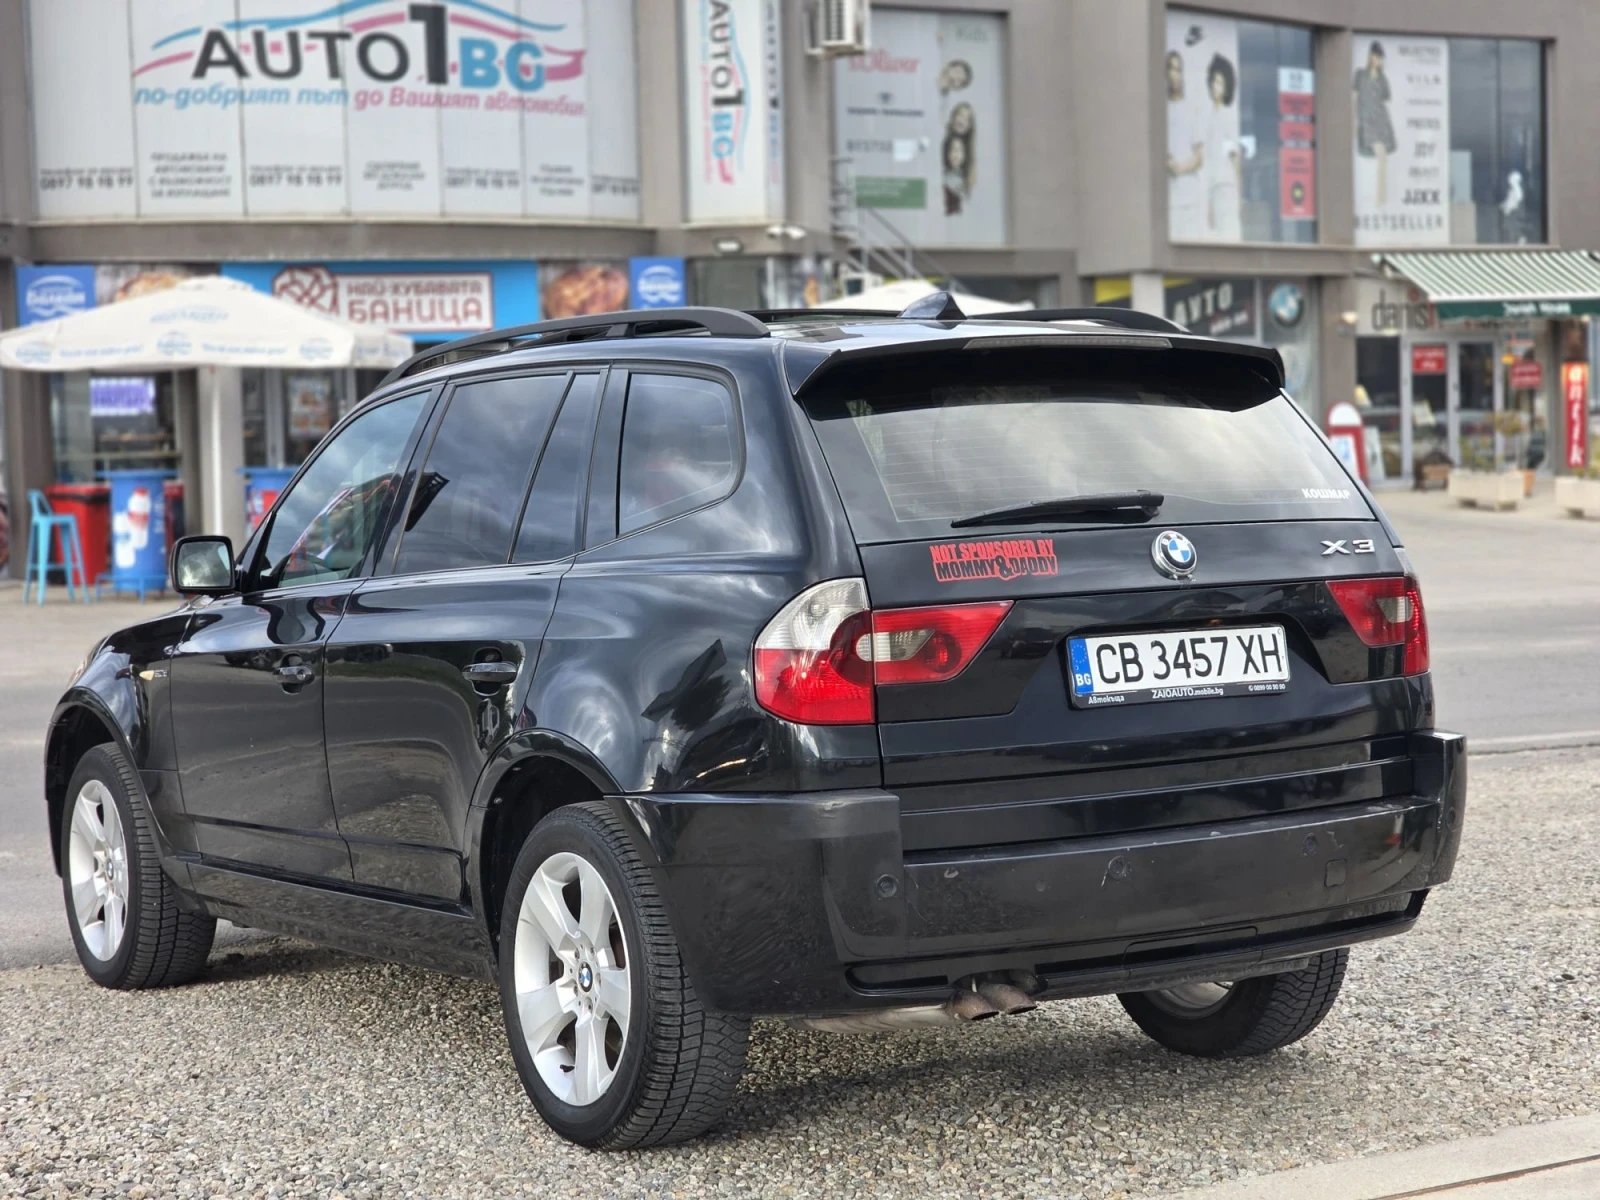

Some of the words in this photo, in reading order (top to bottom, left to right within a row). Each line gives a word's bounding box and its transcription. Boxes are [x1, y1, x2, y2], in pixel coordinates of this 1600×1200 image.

[135, 82, 290, 110] по-добрият
[297, 88, 349, 106] път
[354, 89, 383, 111] до
[348, 298, 483, 327] БАНИЦА
[1301, 488, 1351, 499] КОШМАР
[929, 544, 957, 562] NOT
[959, 540, 1035, 561] SPONSORED
[1036, 539, 1055, 556] BY
[1320, 539, 1376, 556] X3
[1095, 641, 1145, 685] CB
[1150, 636, 1229, 681] 3457
[1235, 633, 1283, 675] XH
[1075, 673, 1092, 687] BG
